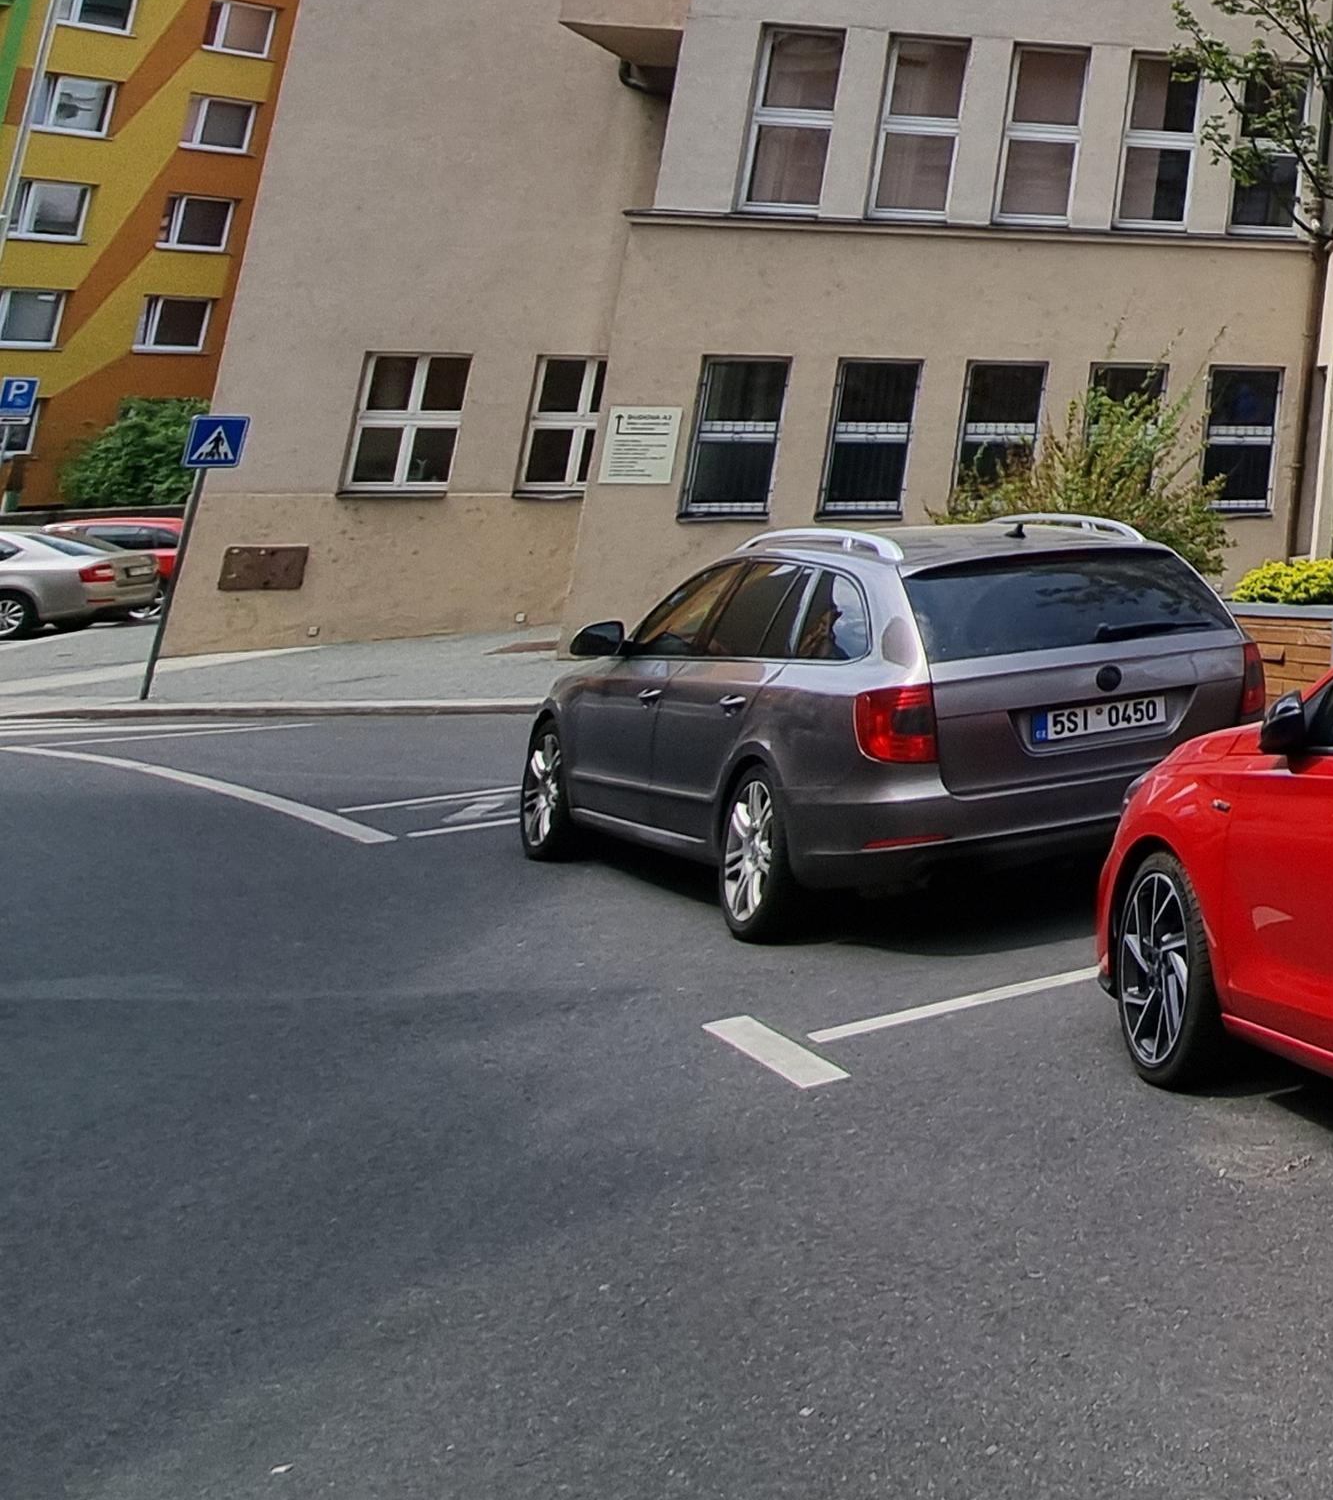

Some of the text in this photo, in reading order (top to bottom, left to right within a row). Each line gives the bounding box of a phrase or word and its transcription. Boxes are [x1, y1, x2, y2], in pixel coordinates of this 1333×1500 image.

[8, 381, 29, 402] P
[1052, 708, 1088, 735] 5SI
[1107, 699, 1157, 727] 0450
